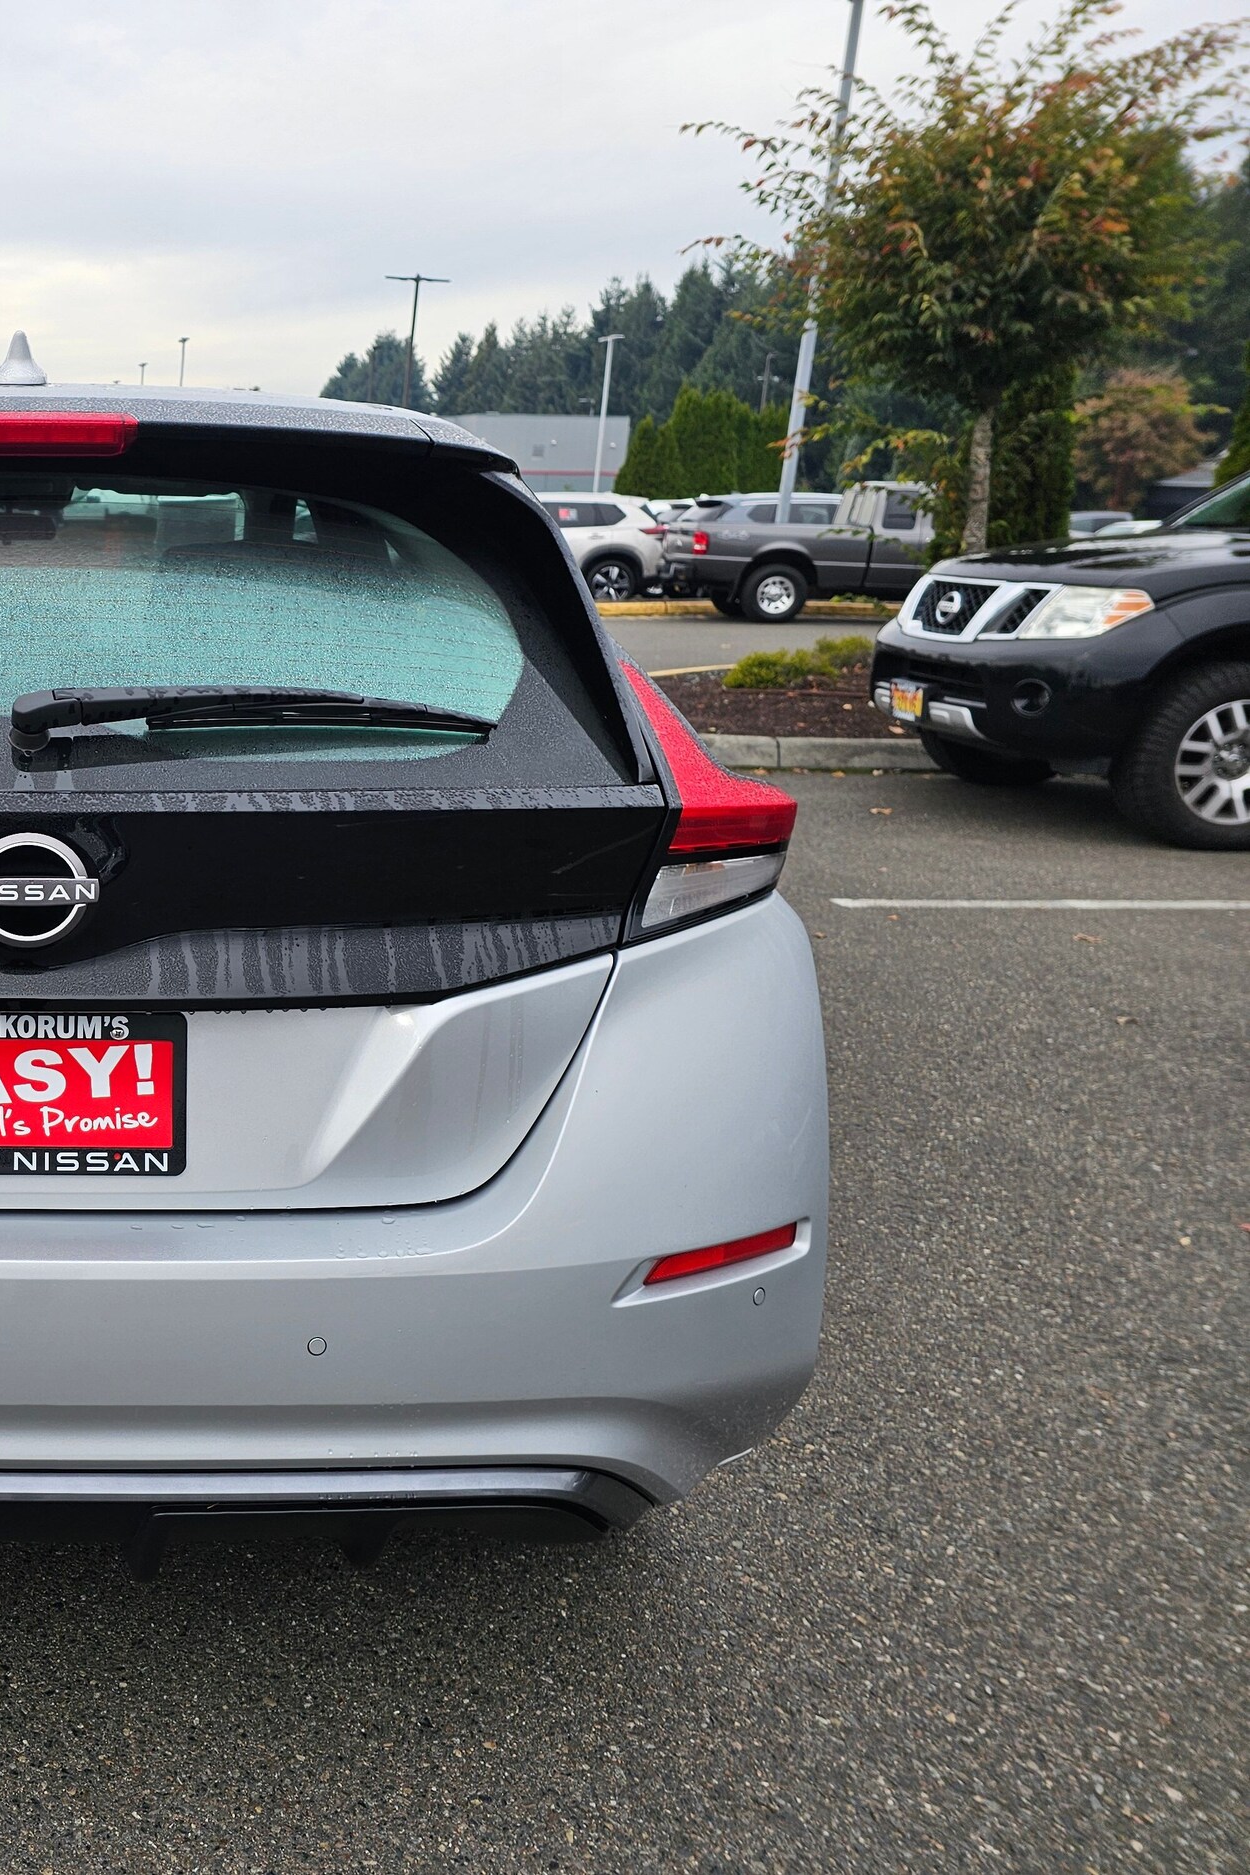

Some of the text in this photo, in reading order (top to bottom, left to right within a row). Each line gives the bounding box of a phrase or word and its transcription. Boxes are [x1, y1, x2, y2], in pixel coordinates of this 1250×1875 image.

[0, 1014, 130, 1039] KORUM'S
[40, 1106, 159, 1137] Promise
[13, 1151, 169, 1172] NISSAN
